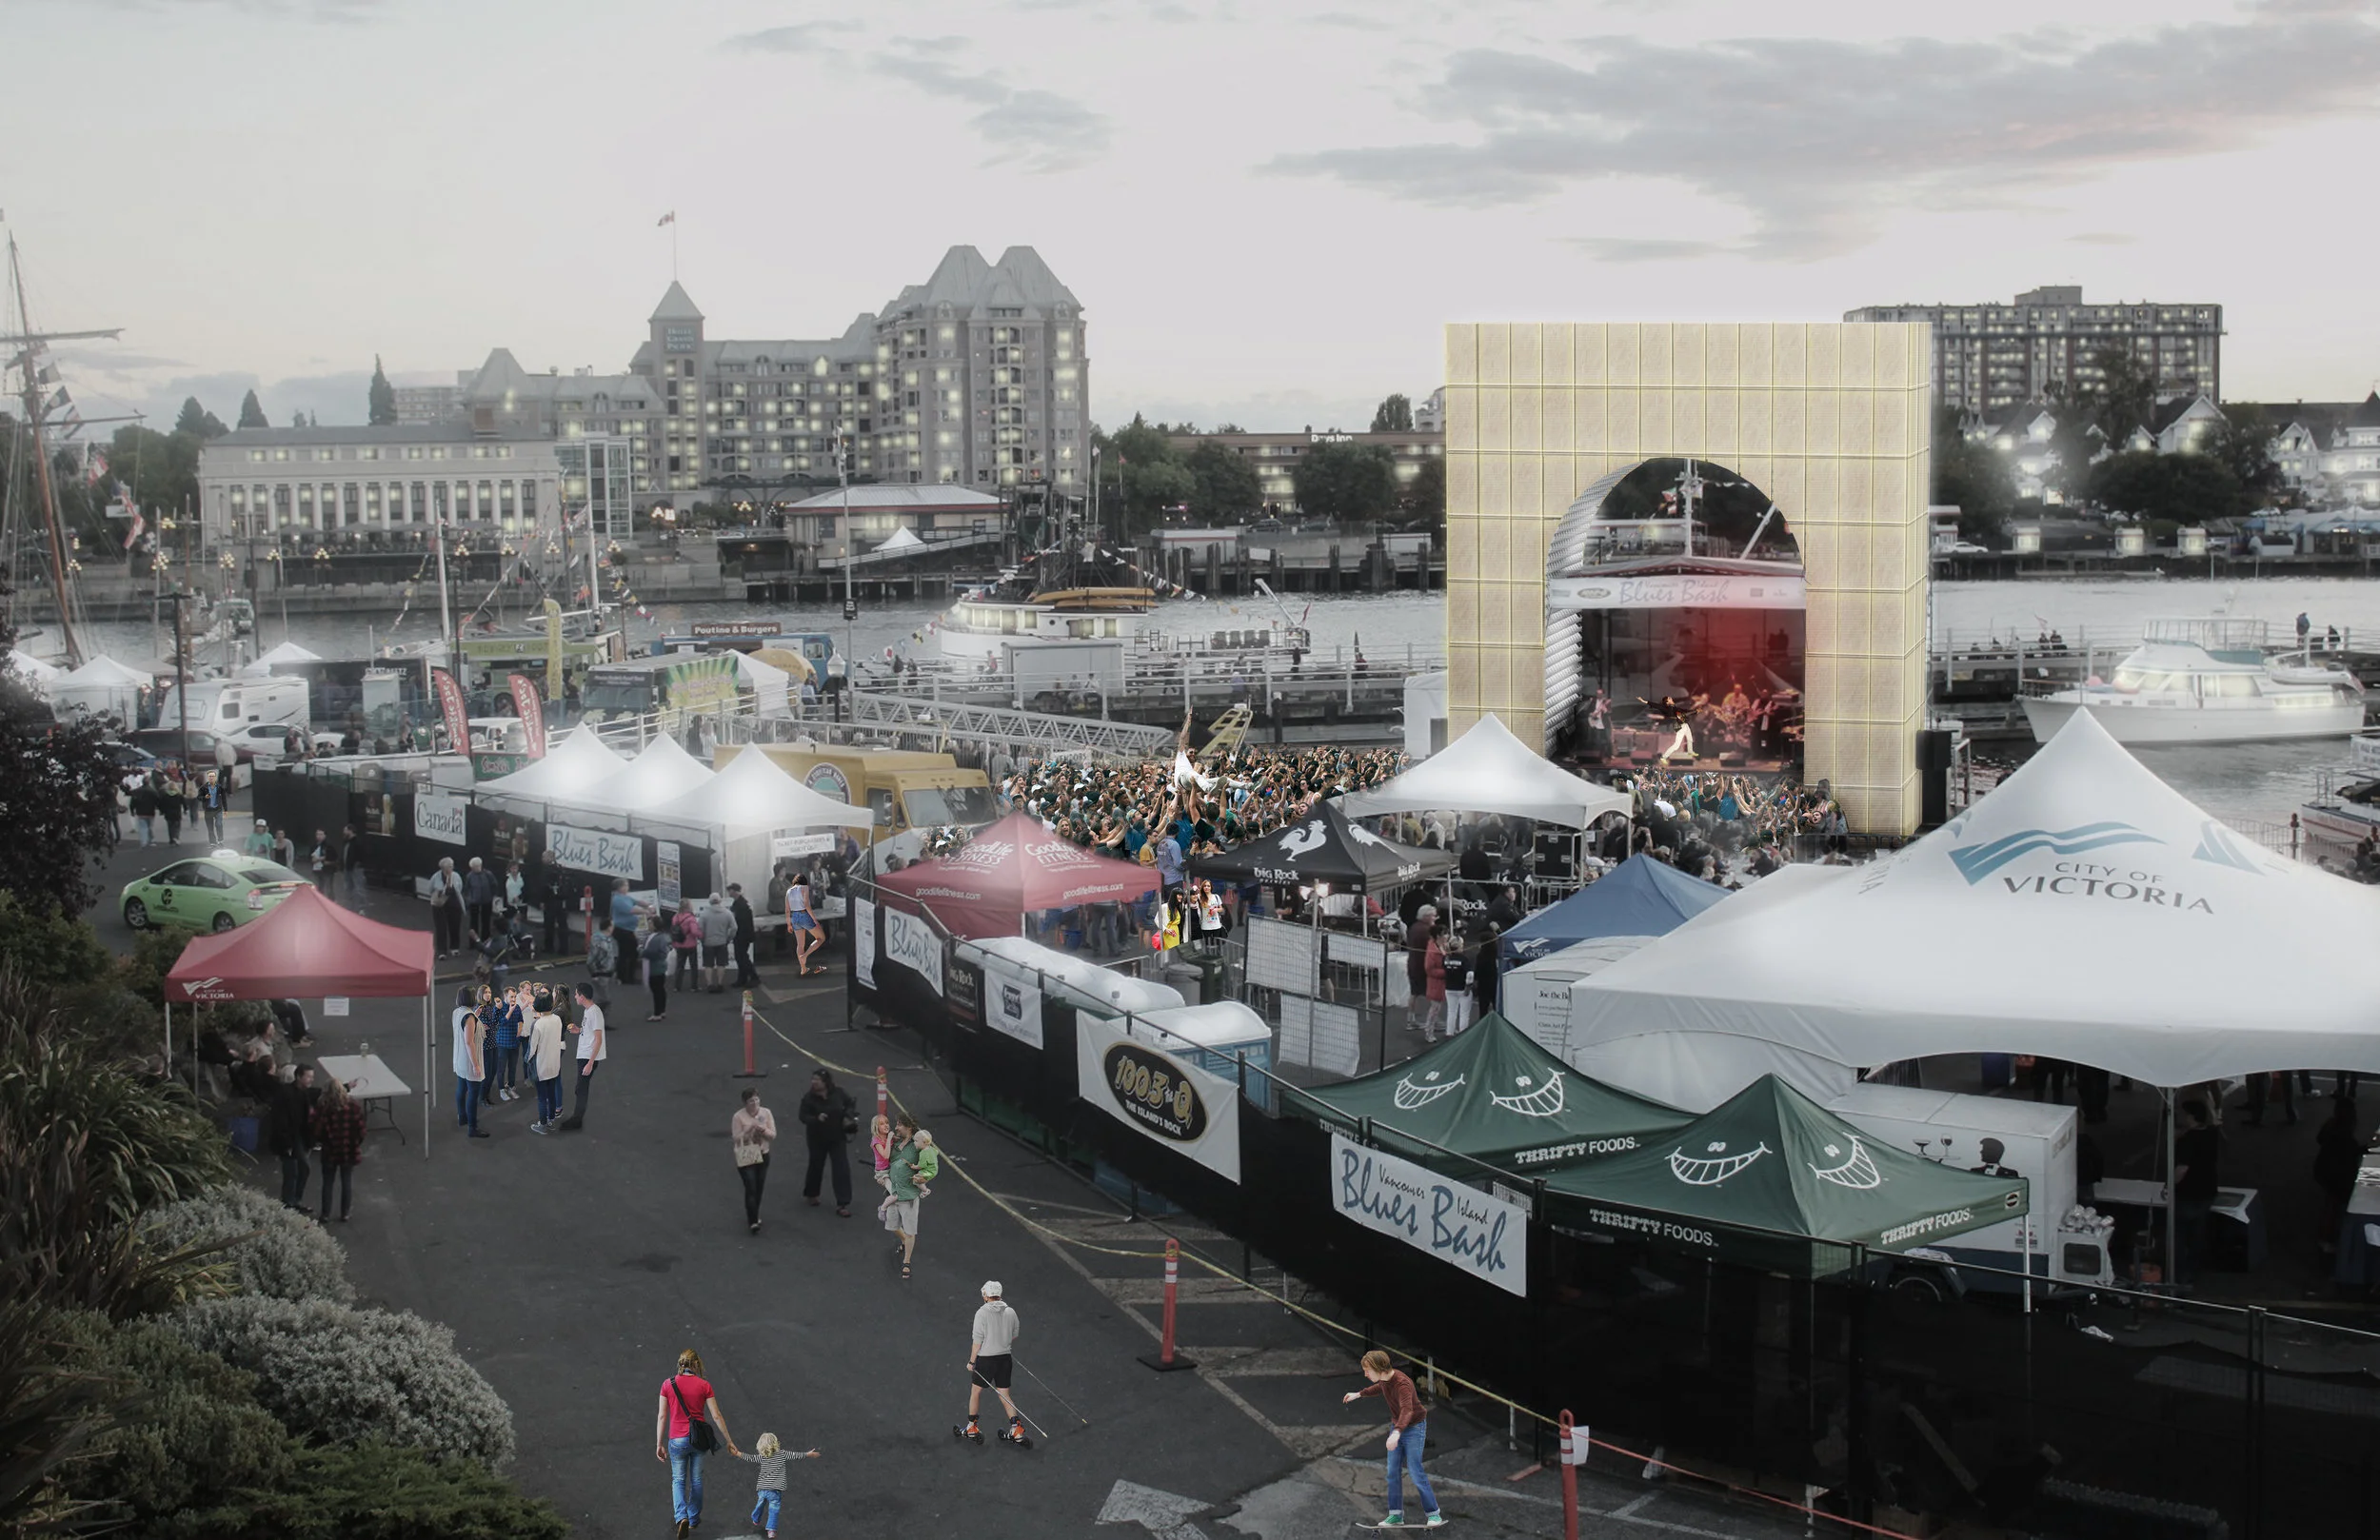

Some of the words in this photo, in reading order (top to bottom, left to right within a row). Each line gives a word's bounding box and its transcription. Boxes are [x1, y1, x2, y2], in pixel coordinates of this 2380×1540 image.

[1619, 581, 1675, 605] Blues
[1680, 579, 1732, 603] Bash
[741, 624, 777, 635] Burgers
[417, 801, 464, 836] Canada
[552, 830, 593, 866] Blues
[598, 838, 634, 873] Bash
[1275, 868, 1299, 880] Rock
[2055, 861, 2117, 877] CITY
[2129, 870, 2164, 883] OF
[916, 887, 982, 900] goodlifefitness.com
[1062, 883, 1124, 900] goodlifefitness.com
[2003, 876, 2215, 915] VICTORIA
[1125, 1099, 1137, 1114] THE
[1137, 1106, 1162, 1127] ISLAND'S
[1163, 1118, 1181, 1136] ROCK
[1174, 1081, 1193, 1131] Q
[1515, 1142, 1587, 1165] THRIFTY
[1589, 1135, 1636, 1154] FOODS
[1341, 1148, 1418, 1236] Blues
[1431, 1184, 1506, 1273] Bash
[1379, 1163, 1425, 1199] Vancouver
[1457, 1195, 1488, 1225] Island
[1590, 1208, 1662, 1234] THRIFTY
[1663, 1222, 1713, 1247] FOODS
[1880, 1216, 1935, 1245] THRIFTY
[1935, 1207, 1971, 1229] FOODS
